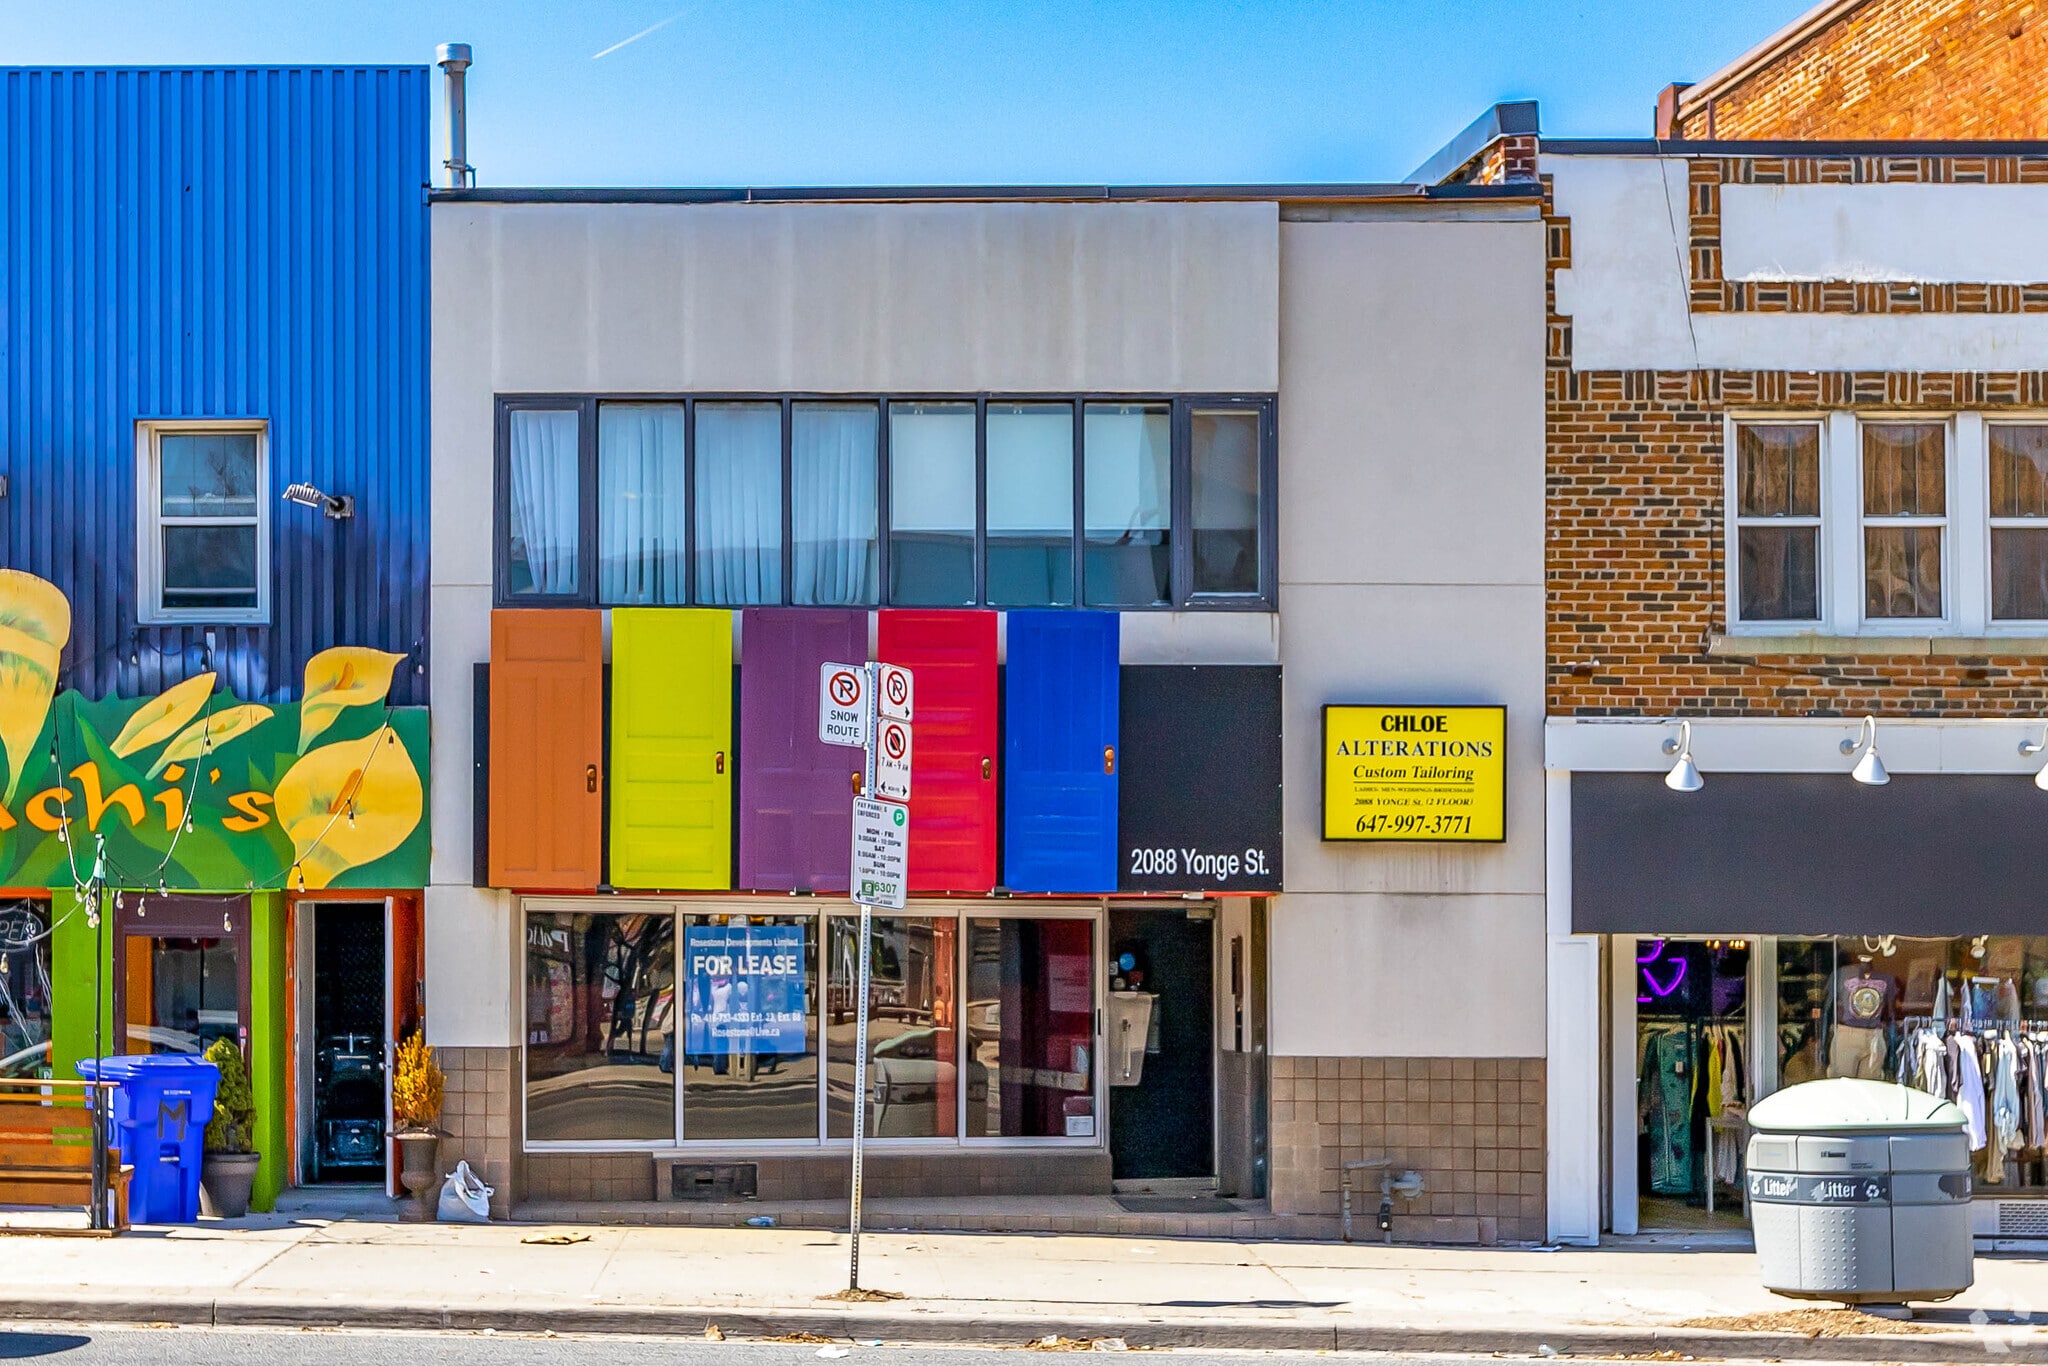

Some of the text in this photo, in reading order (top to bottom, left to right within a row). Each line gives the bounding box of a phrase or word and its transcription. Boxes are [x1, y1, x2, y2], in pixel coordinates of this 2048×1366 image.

[830, 710, 859, 723] SNOW
[1380, 715, 1449, 732] CHLOE
[827, 724, 860, 738] ROUTE
[1336, 740, 1493, 757] ALTERATIONS
[1353, 765, 1475, 781] Custom Tailoring
[0, 761, 274, 832] chi's
[1377, 798, 1411, 806] YONGE
[867, 803, 888, 813] PARKG
[1356, 815, 1472, 833] 647-997-3771
[866, 827, 880, 836] MON
[884, 830, 895, 839] FRI
[874, 845, 885, 853] SAT
[873, 861, 886, 869] SUN
[1131, 848, 1270, 881] 2088 Yonge St.
[874, 882, 897, 894] 6307
[693, 955, 798, 976] FOR LEASE
[158, 1099, 187, 1141] M
[1764, 1179, 1791, 1196] Litter
